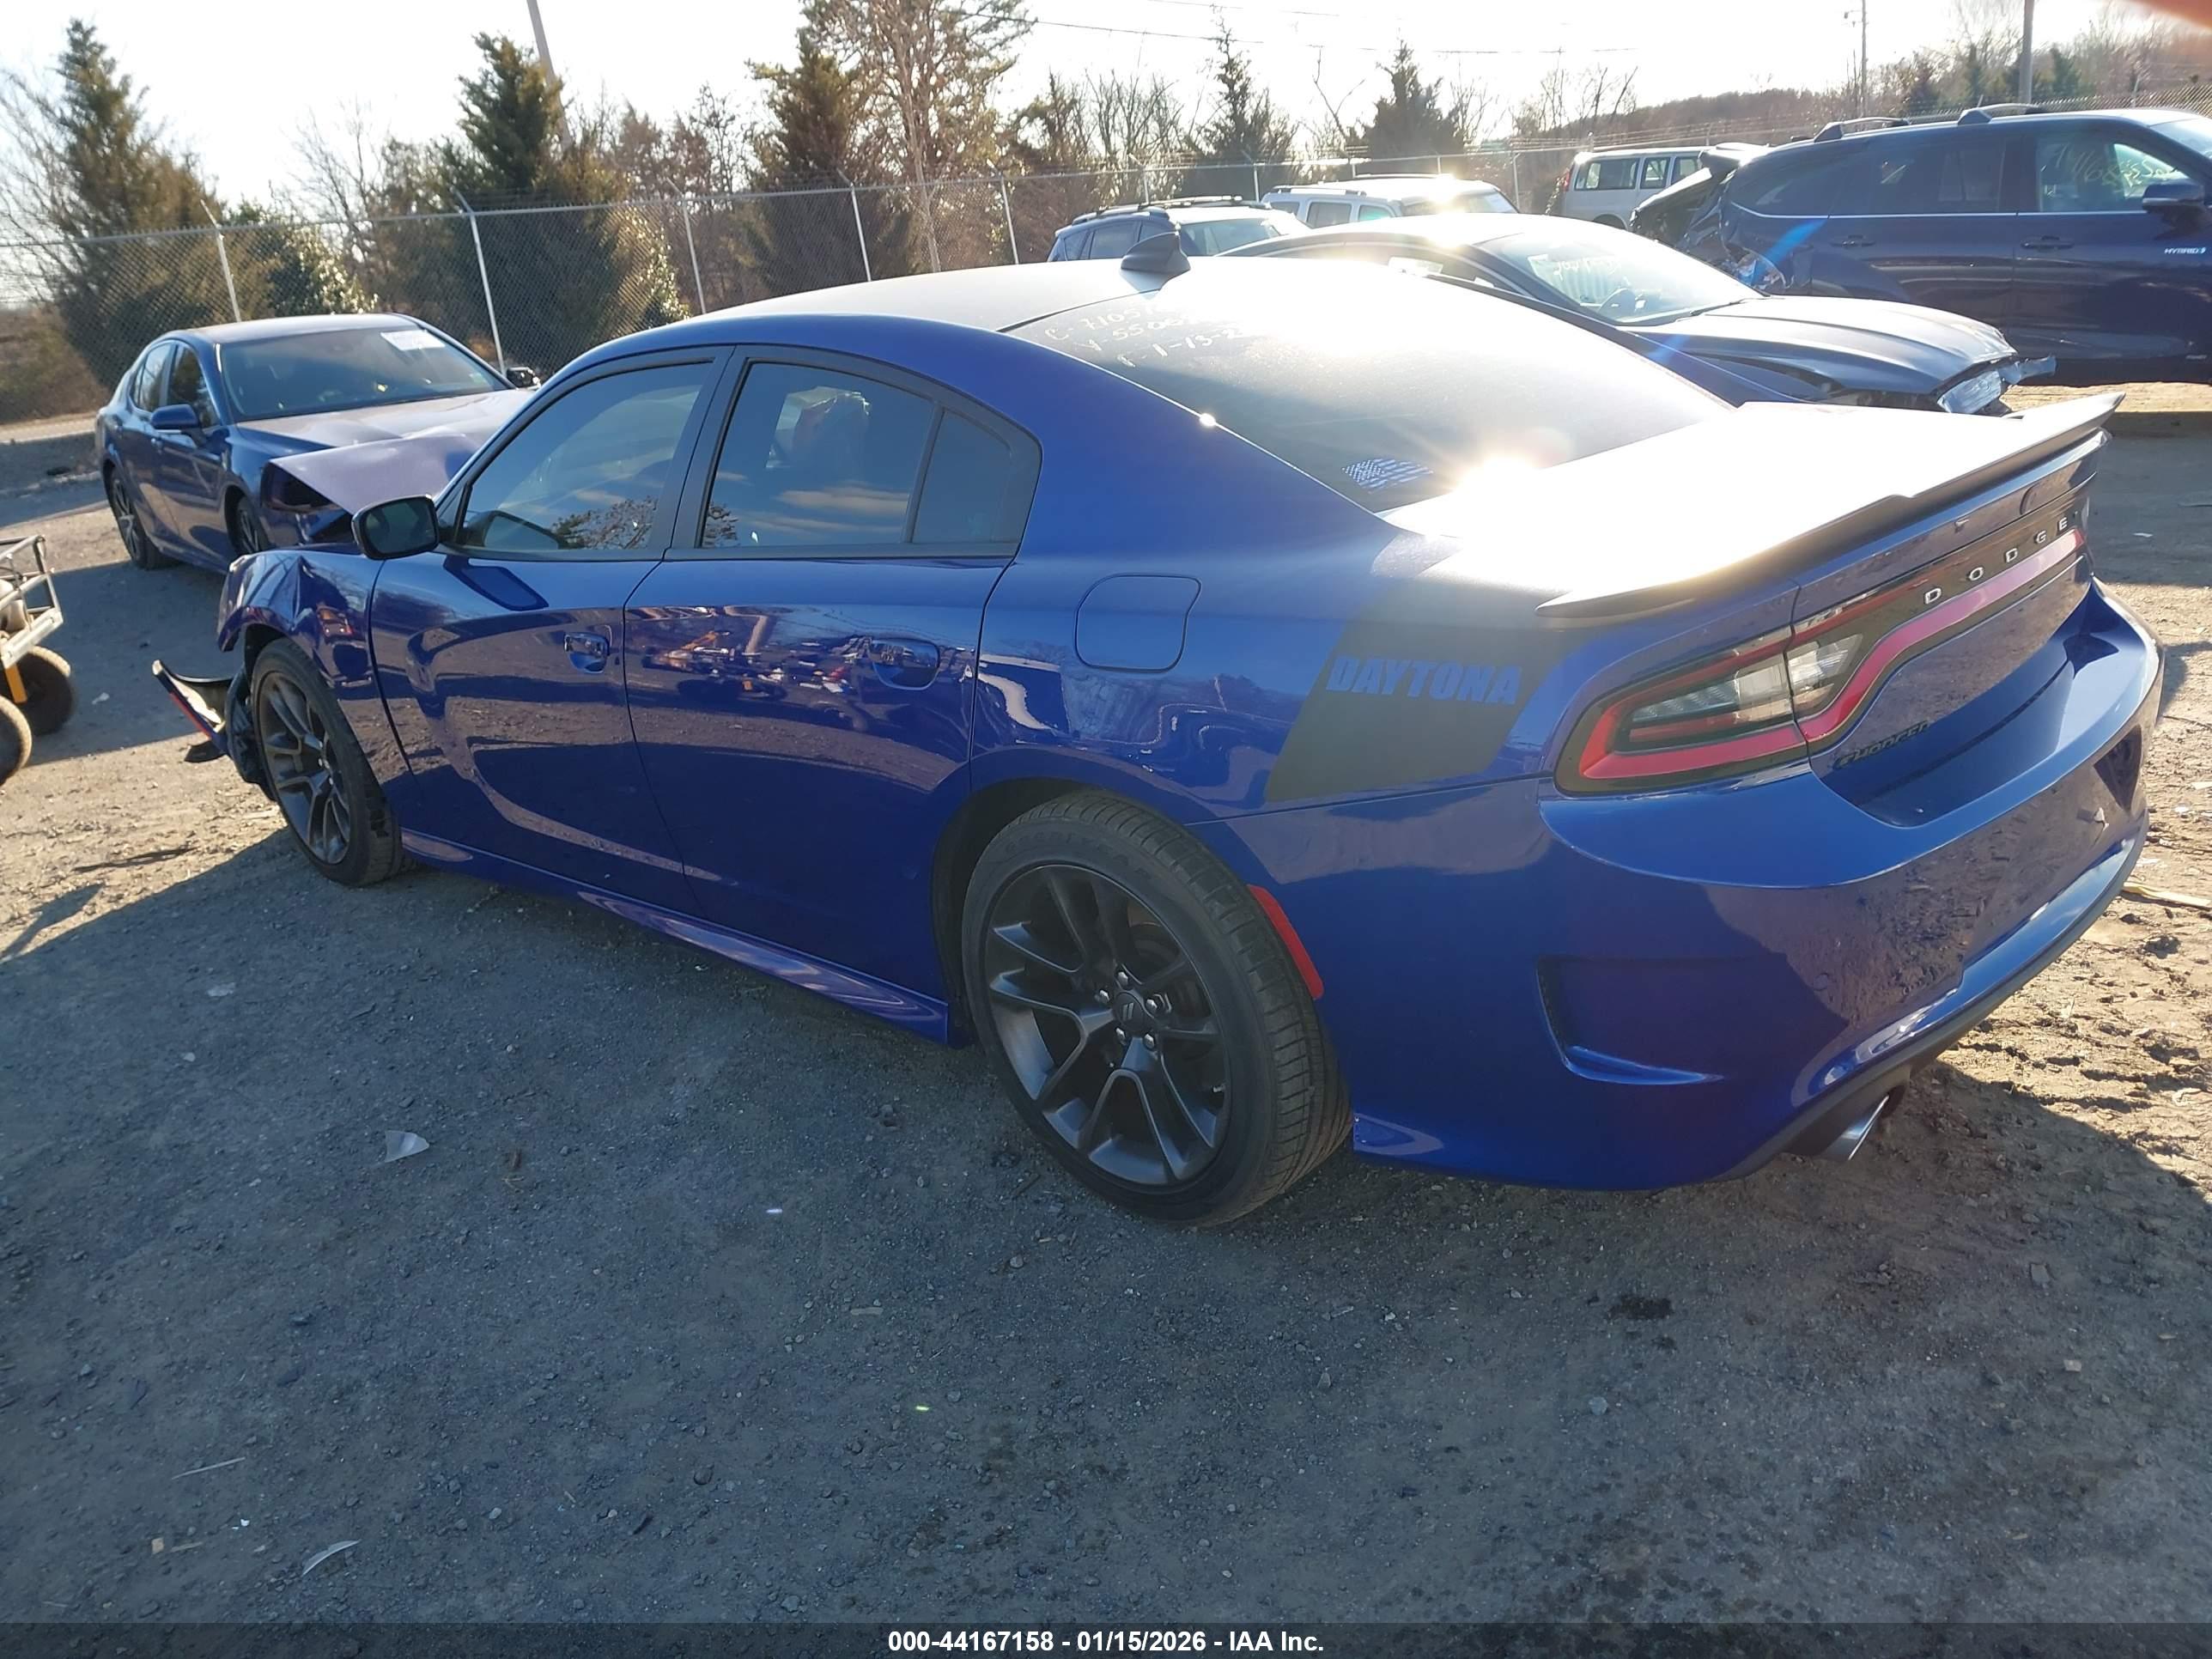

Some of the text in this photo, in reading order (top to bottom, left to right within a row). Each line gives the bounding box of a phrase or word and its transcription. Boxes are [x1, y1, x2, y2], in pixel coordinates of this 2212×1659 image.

[2164, 246, 2198, 255] HYBRID
[1923, 517, 2069, 605] DODGE
[1326, 654, 1522, 705] DAYTONA
